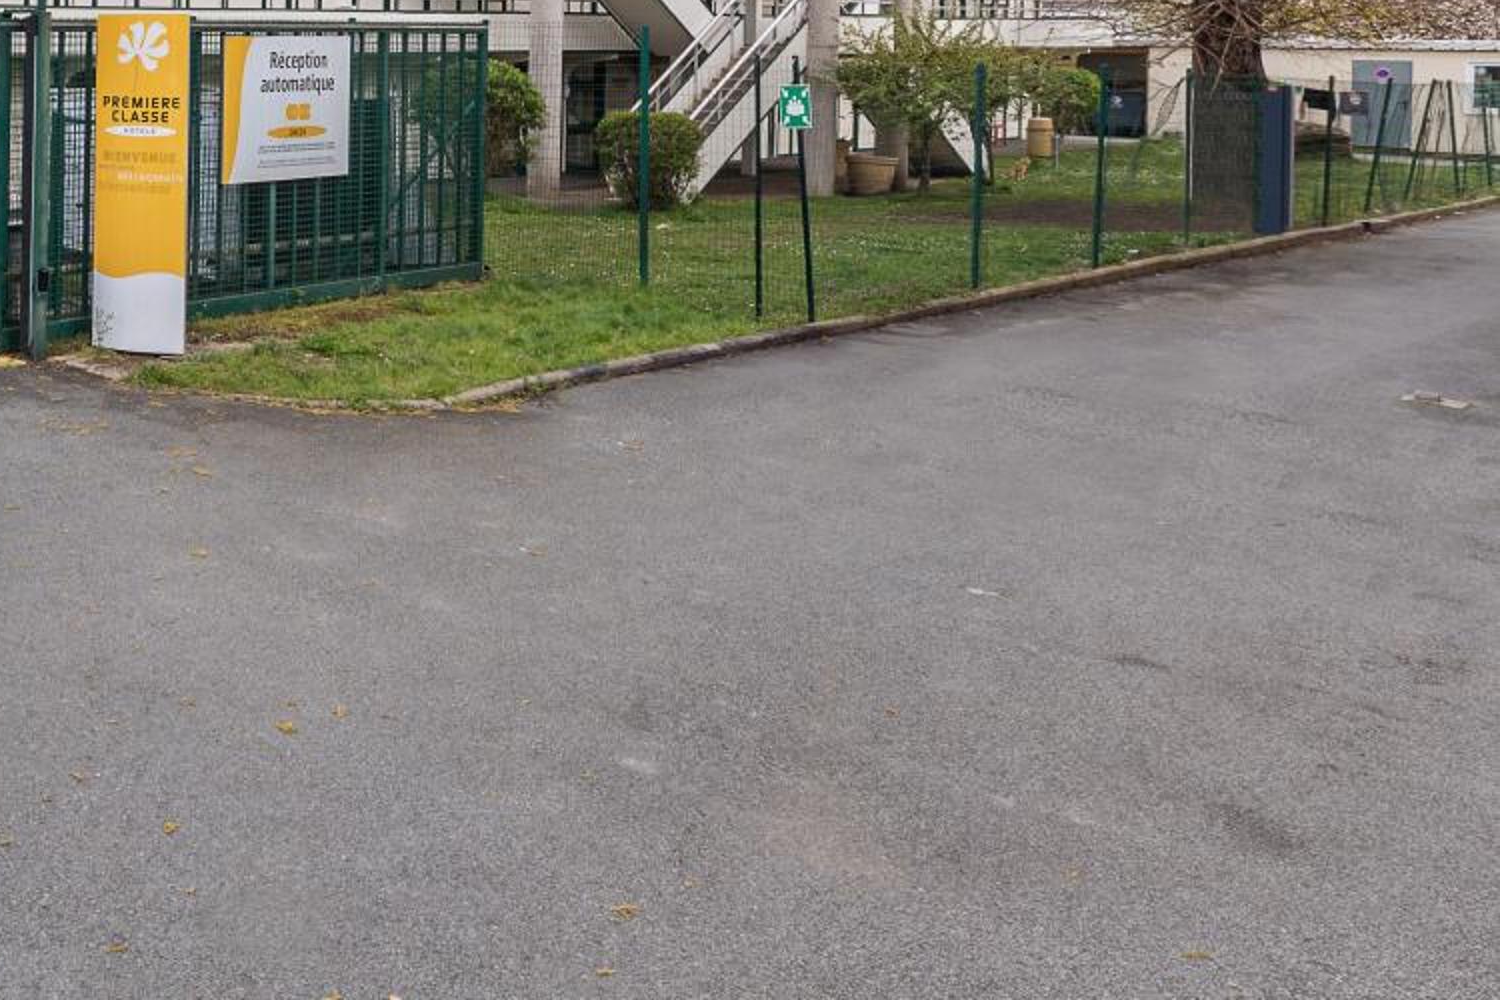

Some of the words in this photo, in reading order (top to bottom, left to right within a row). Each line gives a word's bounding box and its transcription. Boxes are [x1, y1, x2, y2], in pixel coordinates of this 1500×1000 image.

[269, 50, 328, 73] Réception
[260, 73, 335, 96] automatique
[103, 95, 180, 109] PREMIERE
[111, 110, 169, 123] CLASSE
